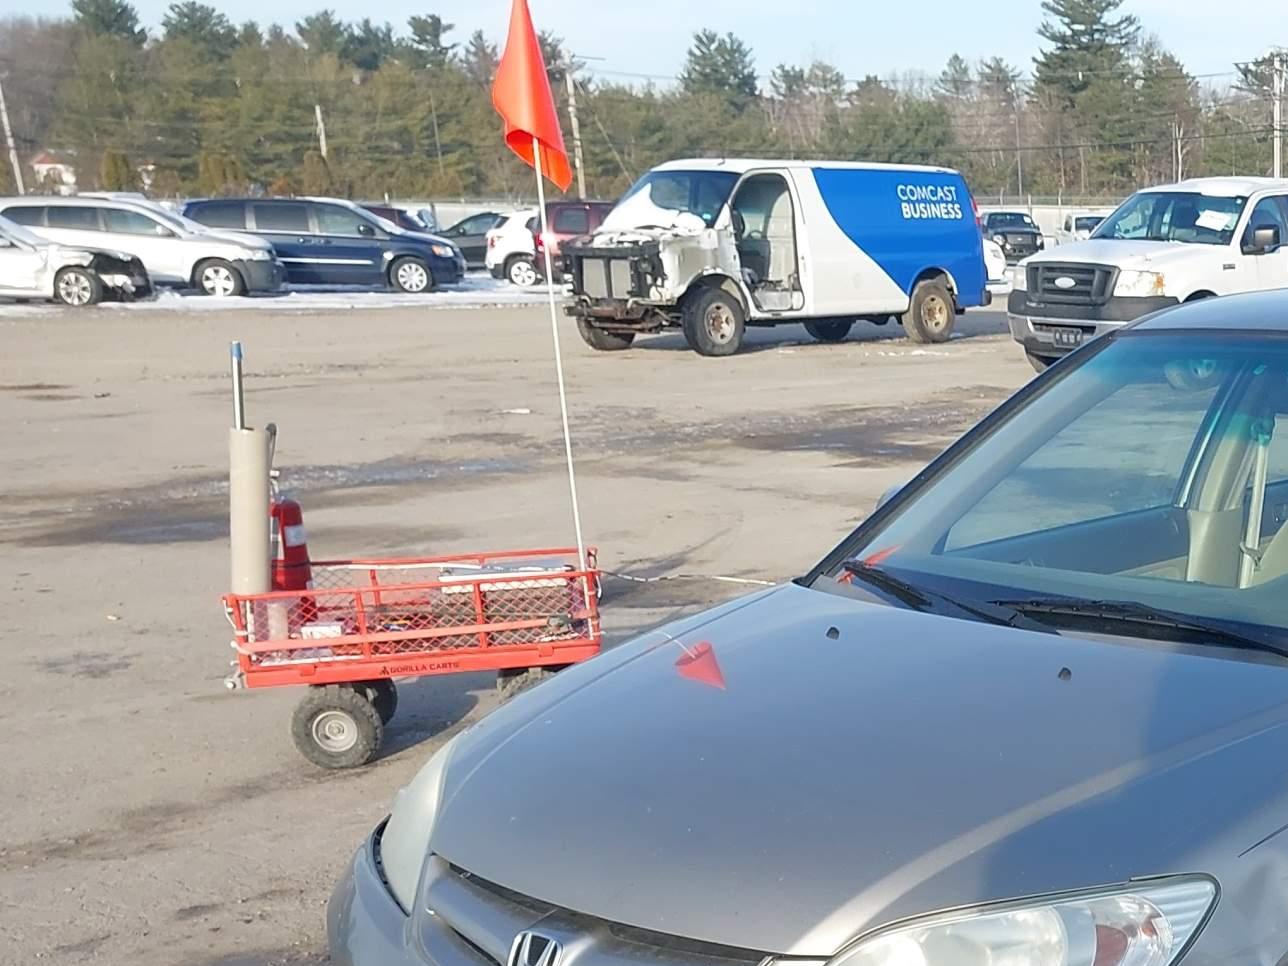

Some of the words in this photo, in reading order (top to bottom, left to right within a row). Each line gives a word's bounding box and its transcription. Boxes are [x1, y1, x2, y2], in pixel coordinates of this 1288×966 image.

[897, 184, 957, 201] COMCAST
[901, 202, 963, 219] BUSINESS
[390, 664, 427, 673] GORILLA
